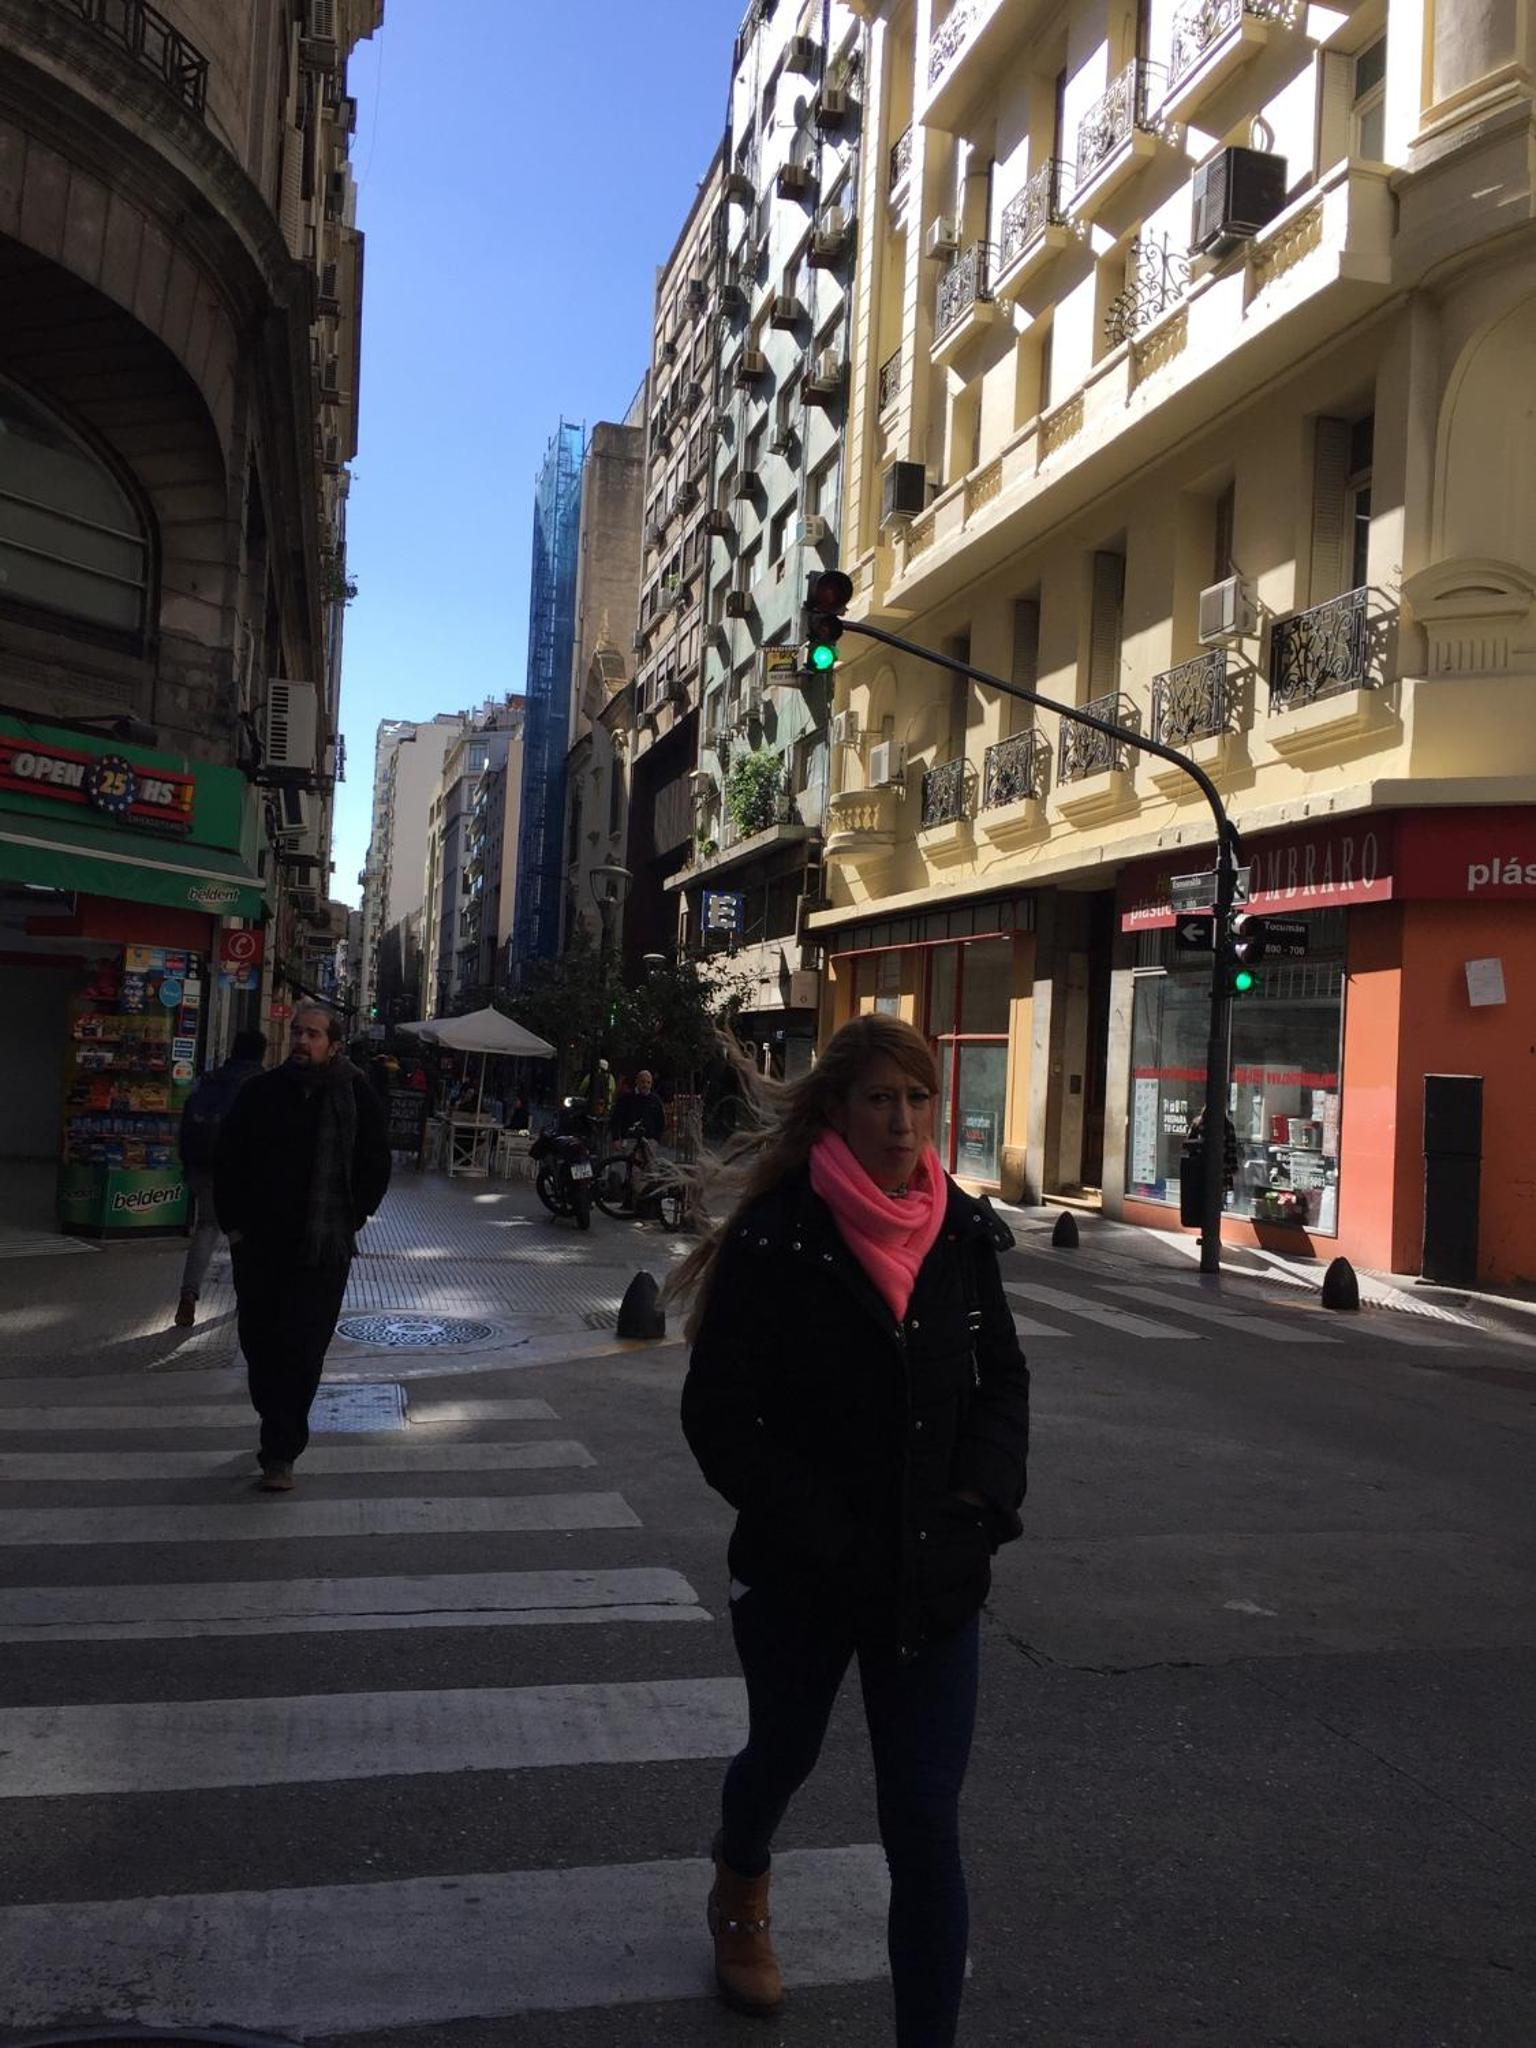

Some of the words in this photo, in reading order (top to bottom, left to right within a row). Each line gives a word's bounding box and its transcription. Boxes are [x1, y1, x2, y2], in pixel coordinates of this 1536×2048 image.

[13, 753, 86, 787] OPEN
[98, 770, 127, 797] 25
[1248, 832, 1378, 904] OMBRARO
[1468, 857, 1536, 892] plás
[187, 886, 240, 904] beldent
[708, 895, 737, 929] E
[1264, 920, 1305, 934] Tucumán
[113, 1184, 184, 1211] beldent
